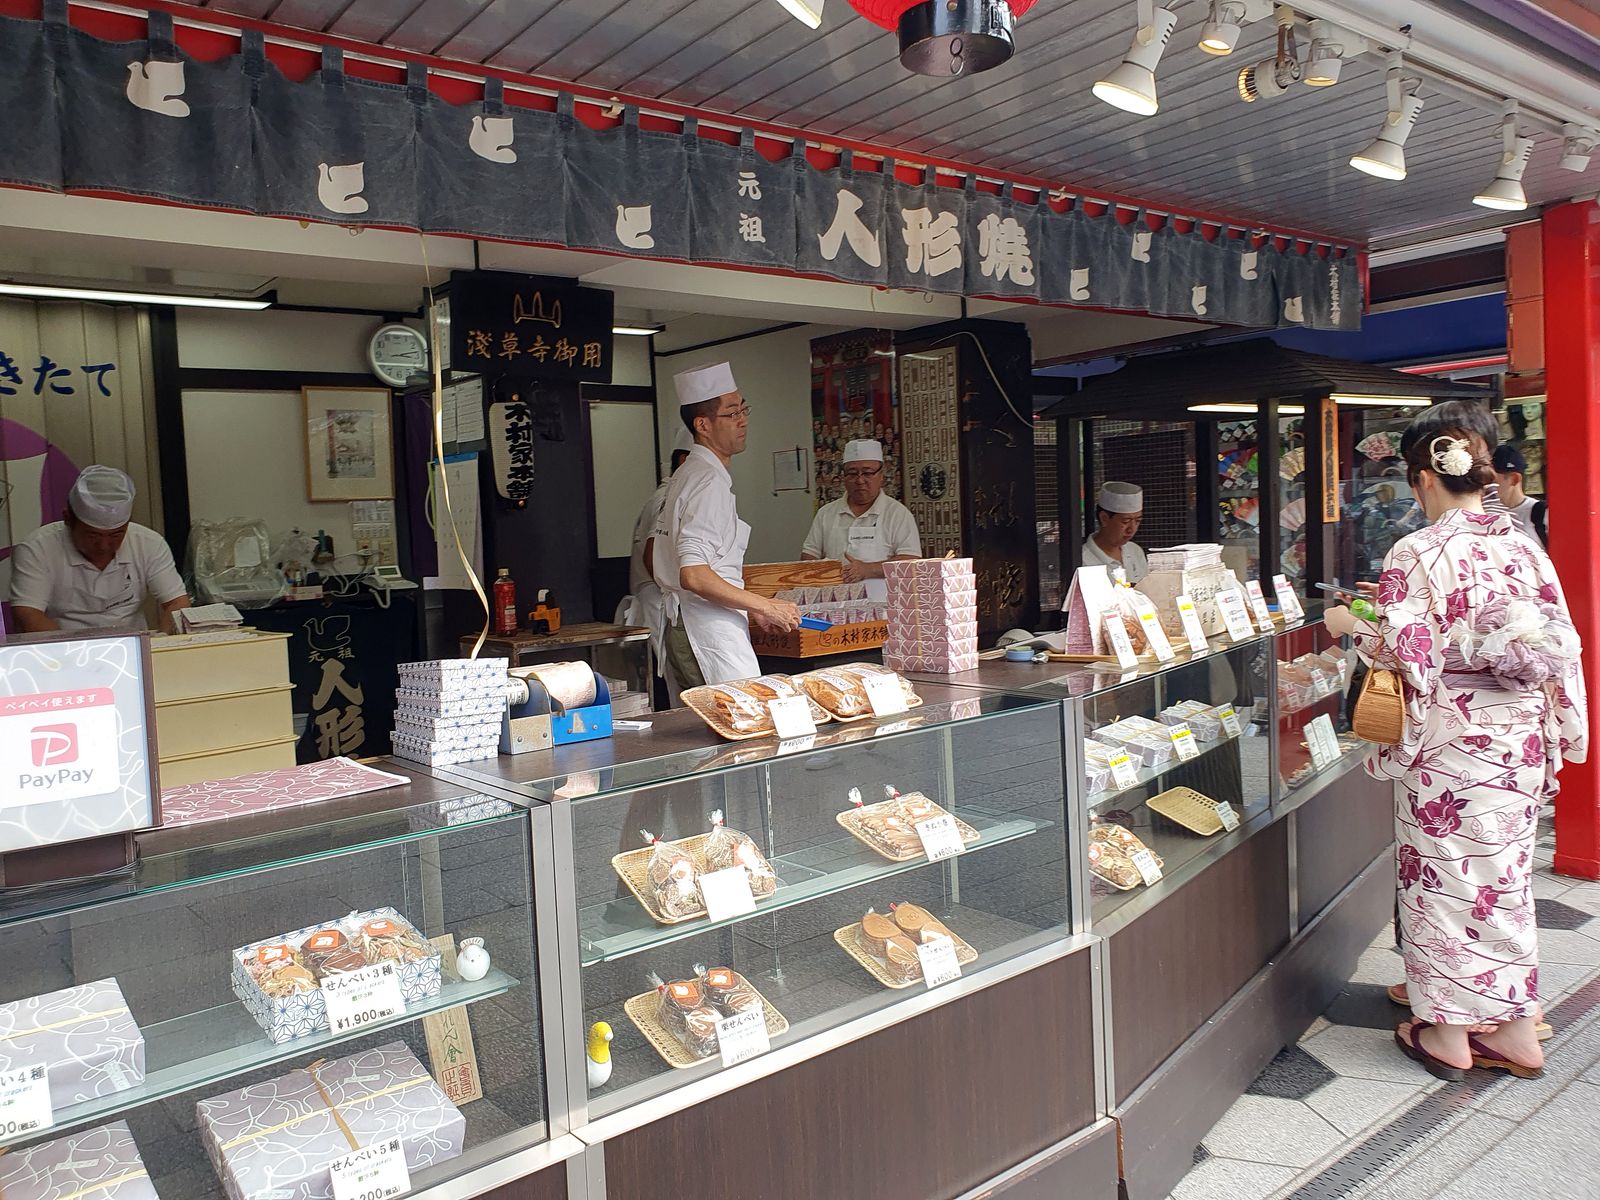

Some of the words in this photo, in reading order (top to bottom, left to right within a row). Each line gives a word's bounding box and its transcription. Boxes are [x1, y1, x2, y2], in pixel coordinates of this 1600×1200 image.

[738, 171, 766, 244] 元祖
[308, 647, 355, 663] 元祖
[5, 694, 97, 711] ペイペイ使えます
[312, 657, 365, 759] 人形
[19, 768, 94, 789] PayPay
